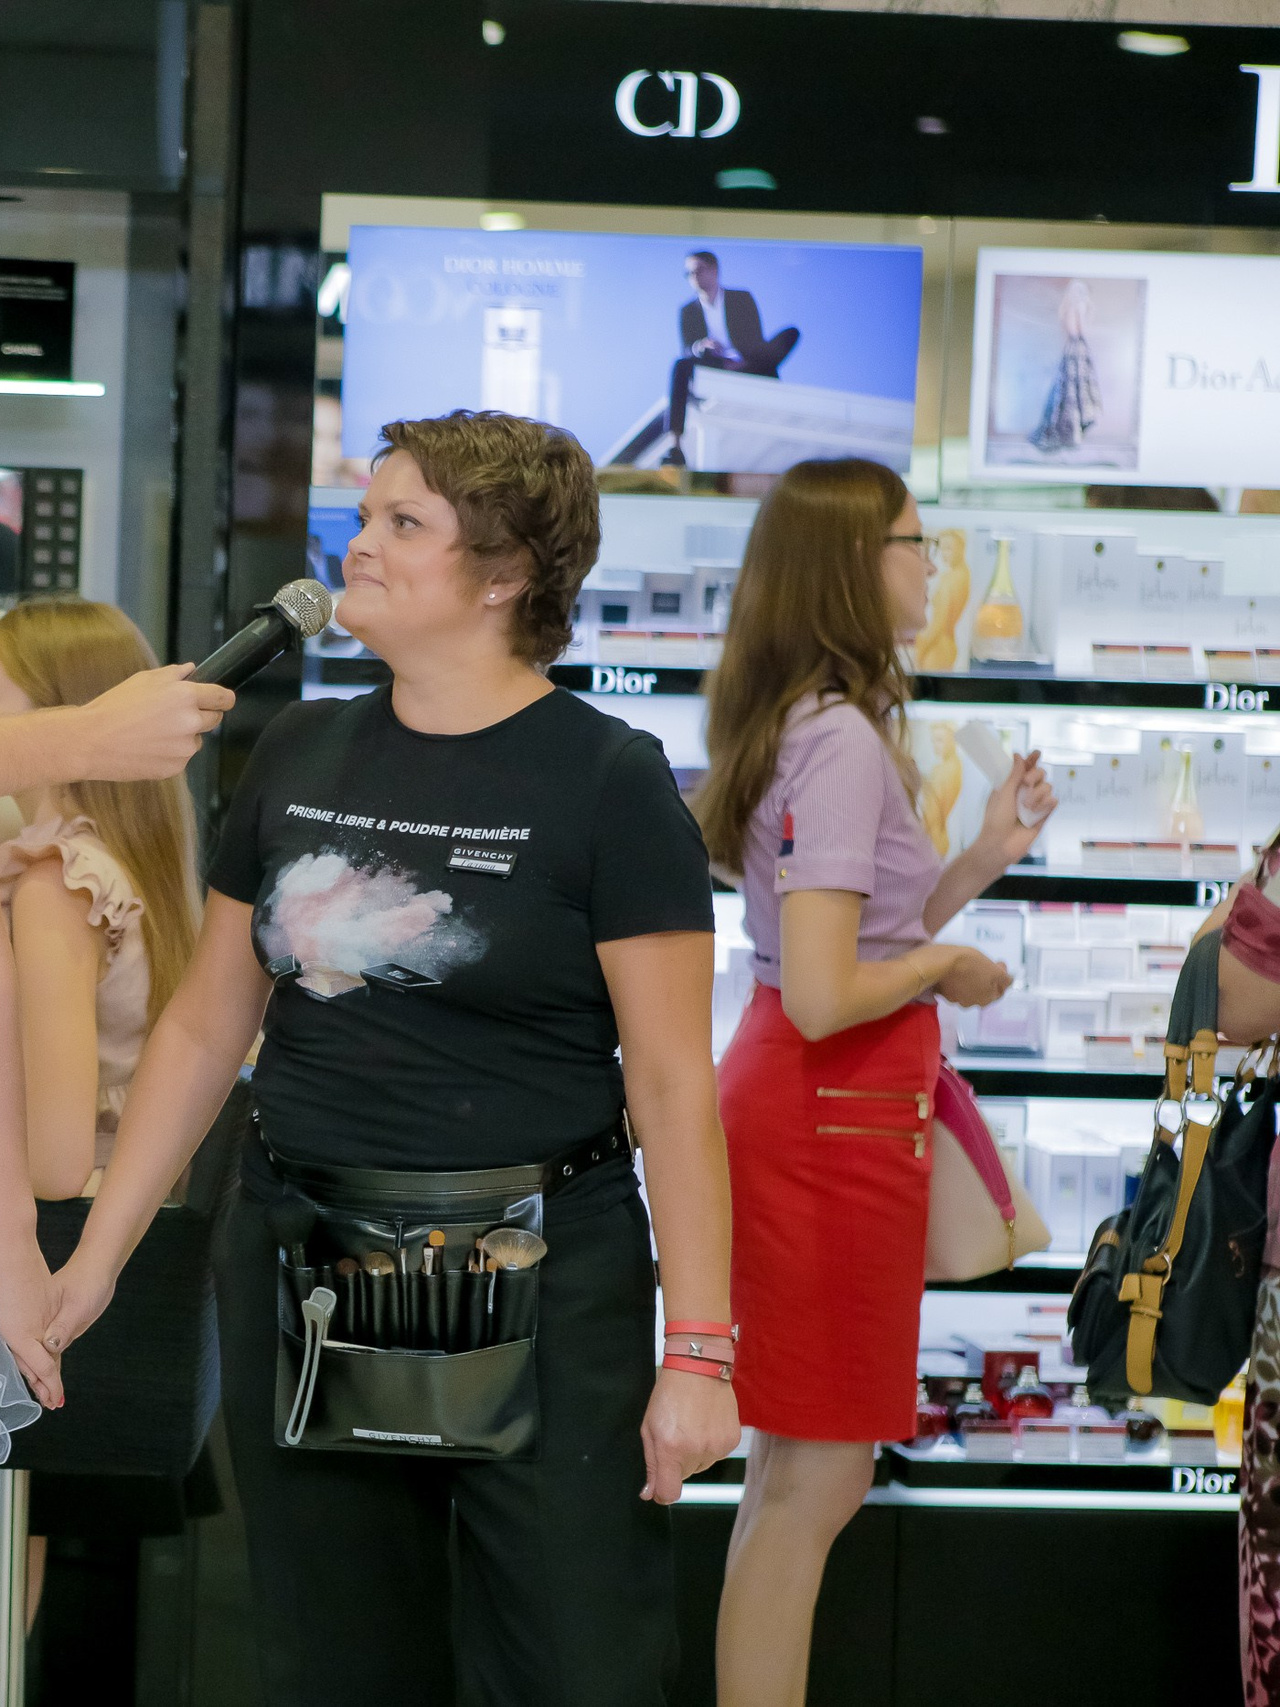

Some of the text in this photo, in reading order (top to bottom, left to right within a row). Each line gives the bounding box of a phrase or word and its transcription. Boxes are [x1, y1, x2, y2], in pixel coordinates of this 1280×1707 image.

[1165, 352, 1280, 393] Dior A
[592, 666, 657, 694] Dior
[1205, 683, 1269, 711] Dior
[286, 804, 531, 840] PRISME LIBRE & POUDRE PREMIÈRE
[453, 847, 513, 861] GIVENCHY
[368, 1432, 433, 1443] GIVENCHY
[1172, 1467, 1236, 1493] Dior
